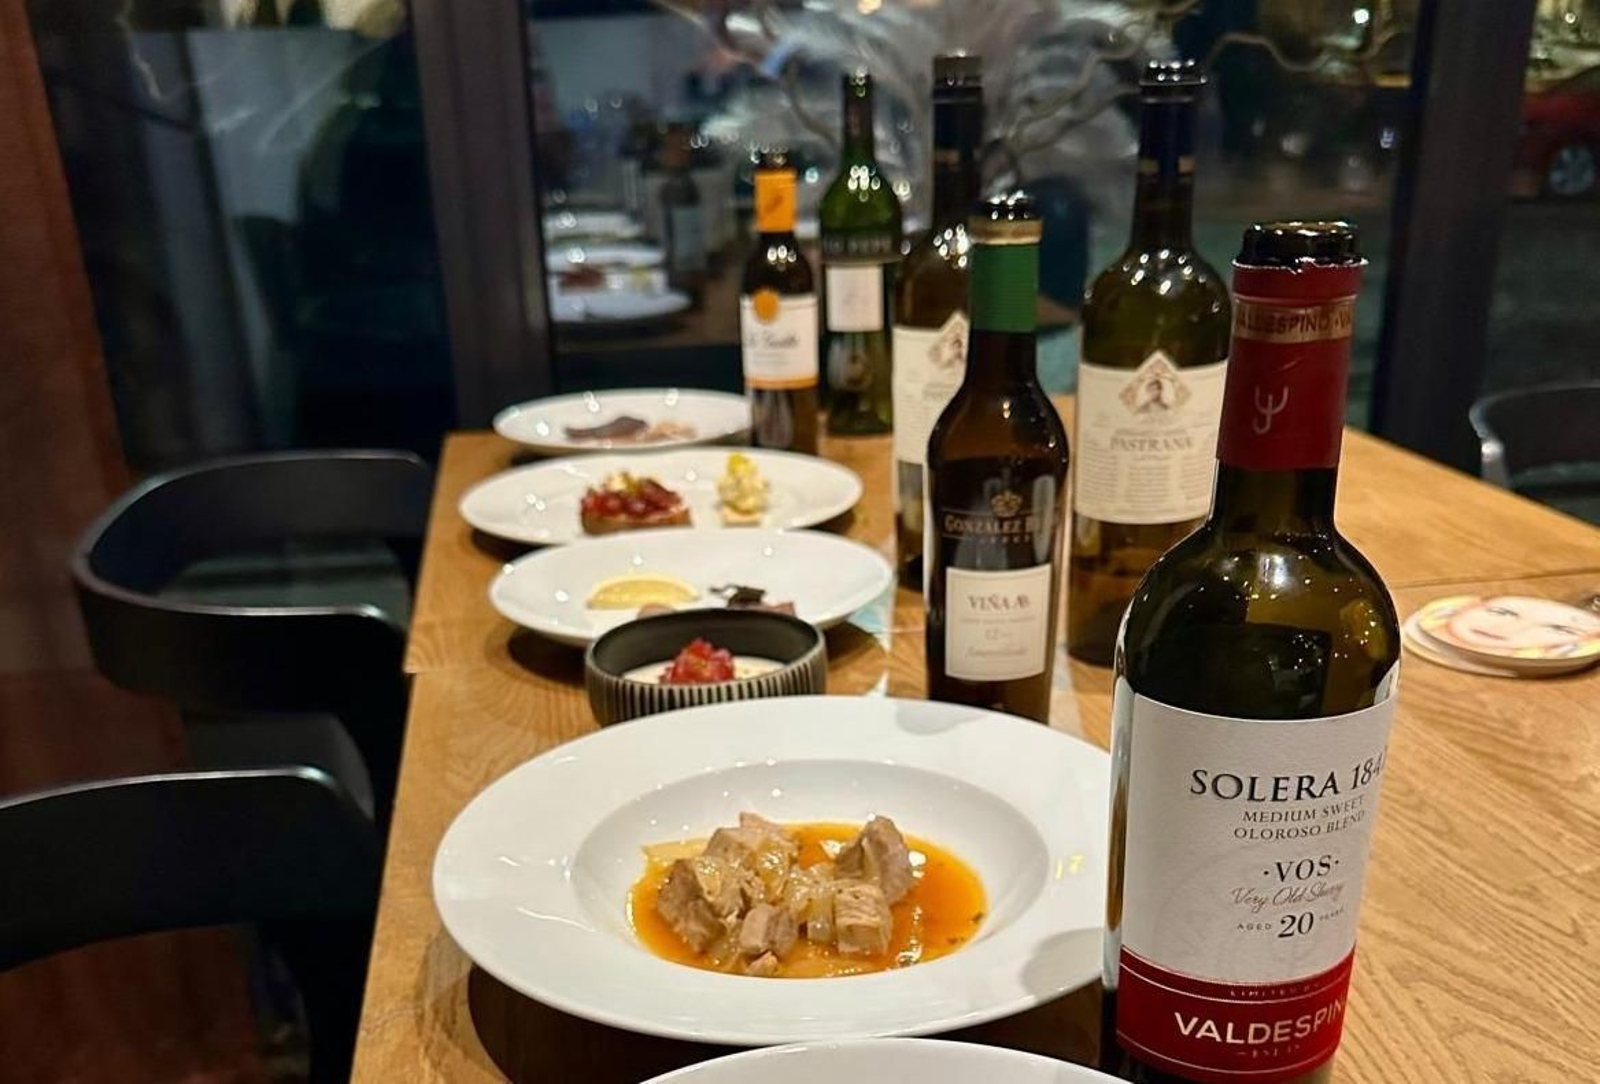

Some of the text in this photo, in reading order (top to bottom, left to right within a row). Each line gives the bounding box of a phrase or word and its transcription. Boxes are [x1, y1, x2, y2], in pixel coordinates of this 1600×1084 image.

[1110, 437, 1191, 452] PASTRANA
[1190, 746, 1386, 802] SOLERA 184
[1242, 794, 1364, 823] MEDIUM SWEET
[1234, 810, 1365, 840] OLOROSO BLEND
[1231, 887, 1268, 914] Very
[1272, 886, 1305, 906] Old
[1237, 922, 1272, 931] AGED
[1278, 911, 1315, 938] 20
[1174, 997, 1345, 1045] VALDESPIN
